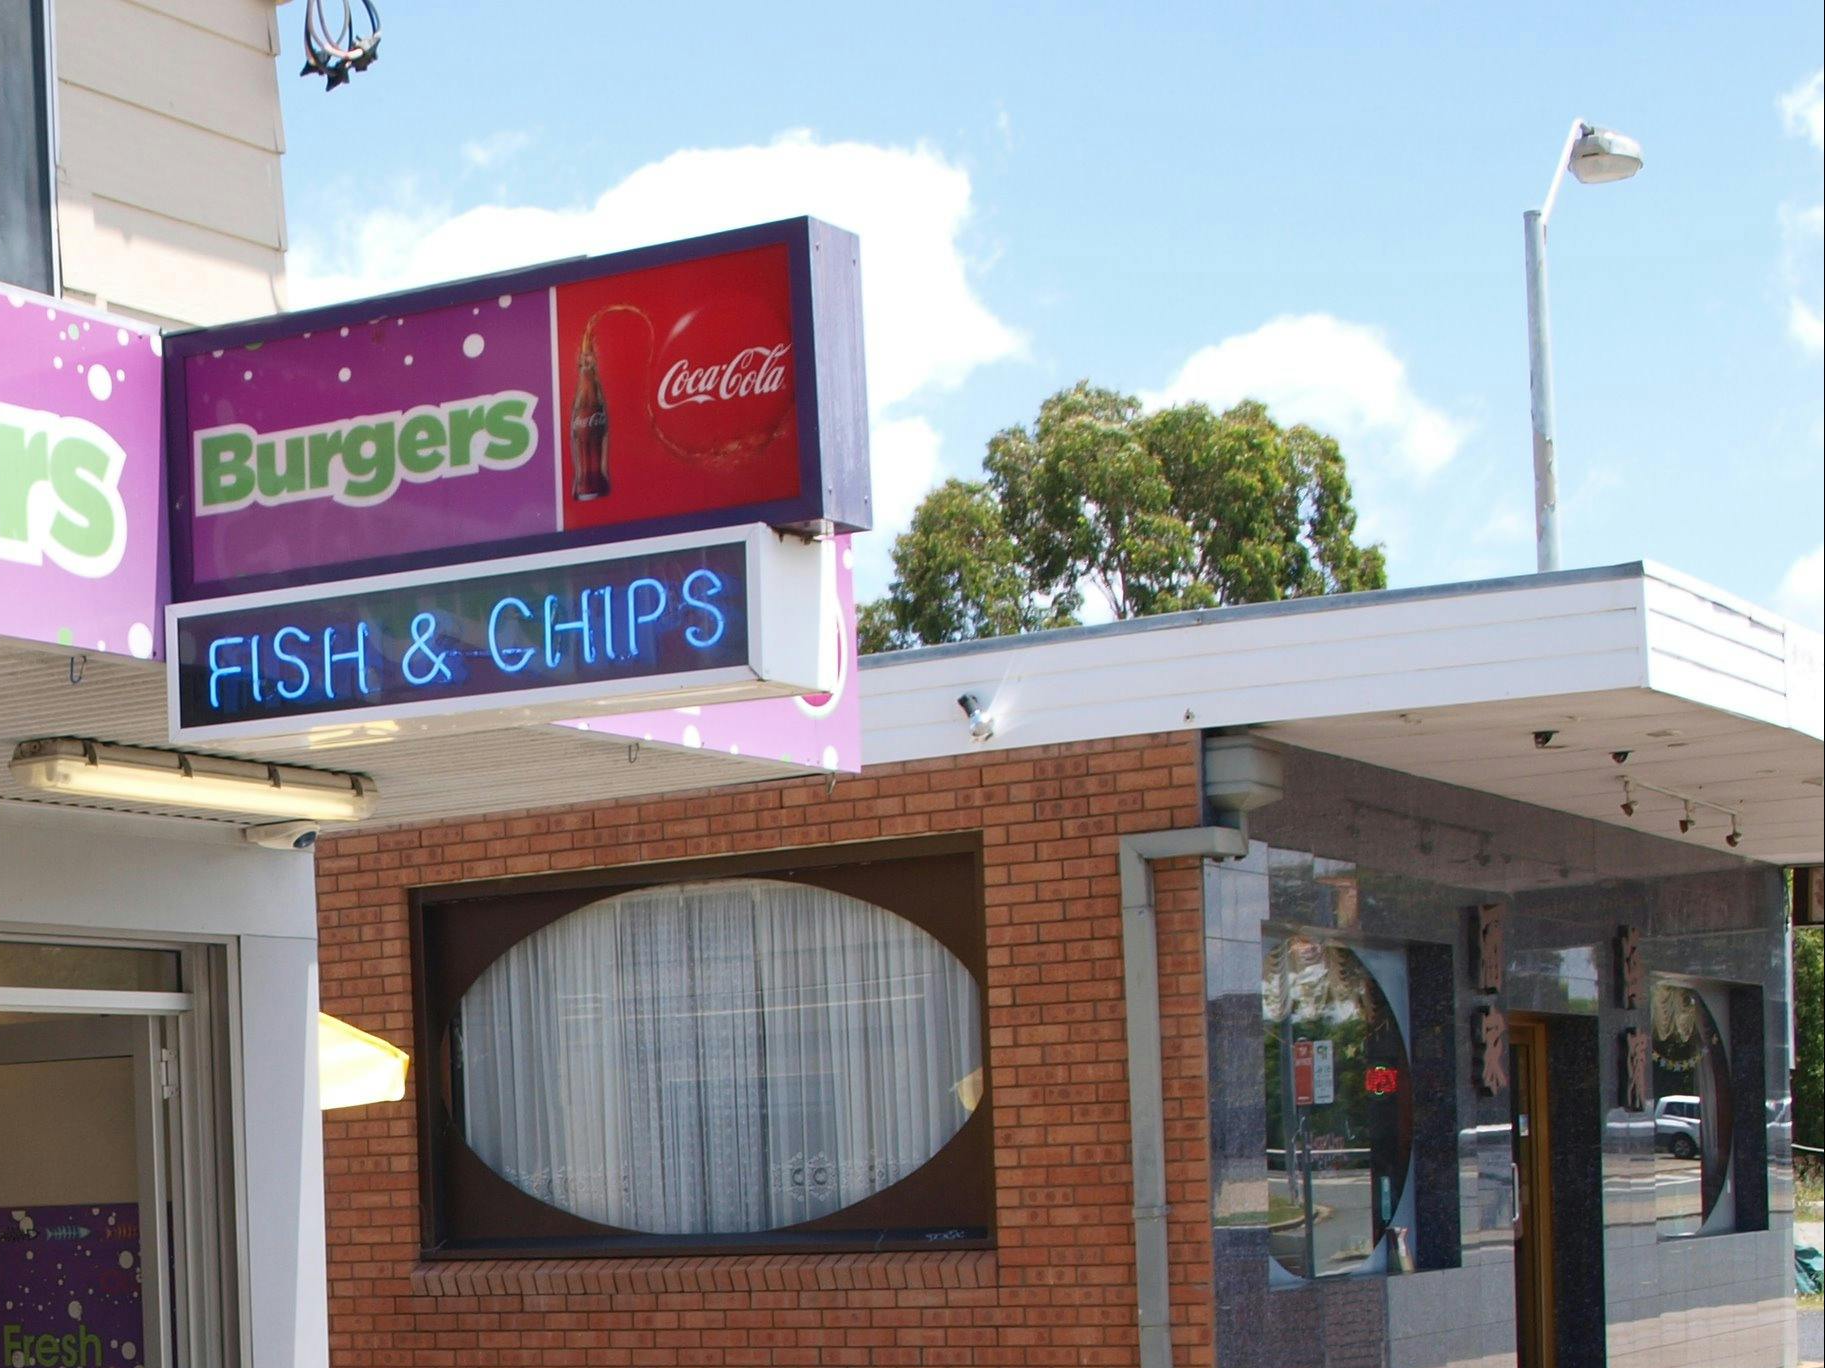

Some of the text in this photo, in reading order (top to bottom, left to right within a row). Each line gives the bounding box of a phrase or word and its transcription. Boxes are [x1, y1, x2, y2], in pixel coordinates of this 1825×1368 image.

[657, 342, 792, 410] Coca-Cola
[196, 392, 538, 516] Burgers
[208, 568, 727, 710] FISH & CHIPS
[3, 1324, 103, 1368] Fresh
